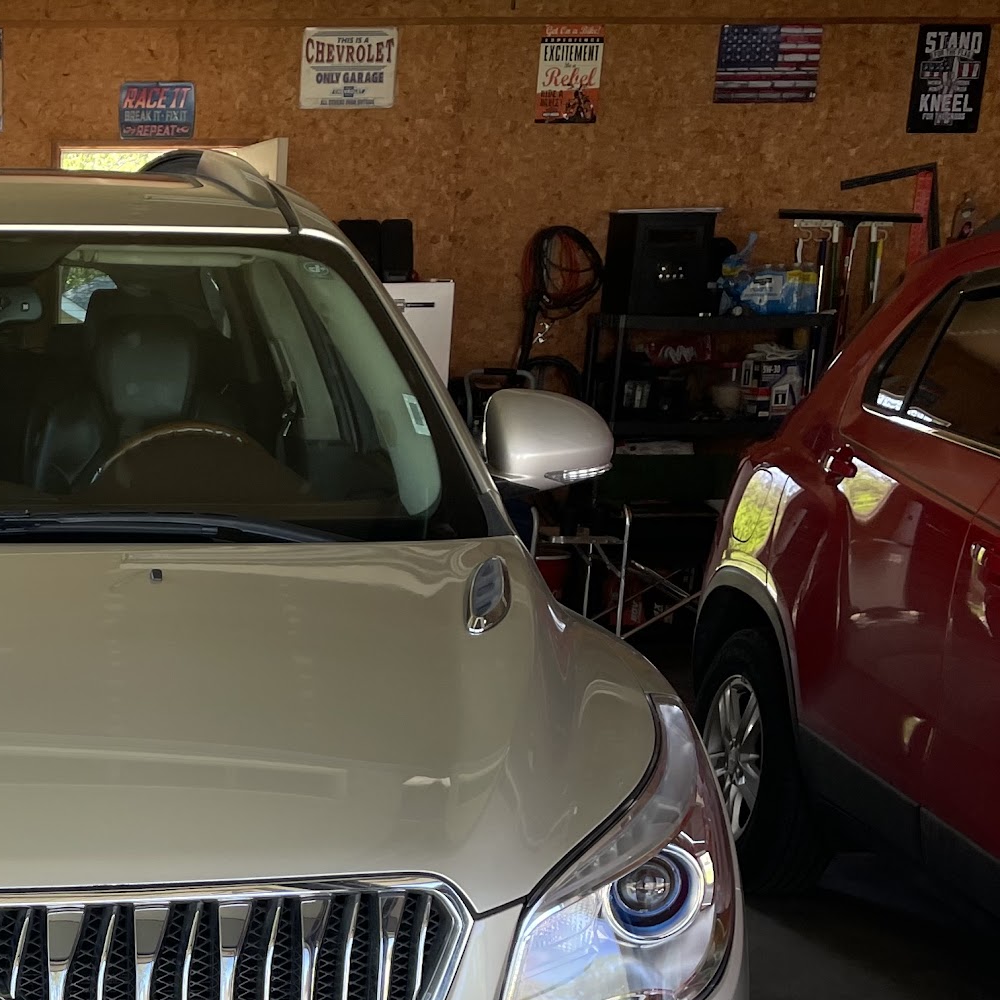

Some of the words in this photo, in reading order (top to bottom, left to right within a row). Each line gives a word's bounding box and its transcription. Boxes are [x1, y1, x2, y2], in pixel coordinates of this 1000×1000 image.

[305, 37, 395, 64] CHEVROLET
[924, 31, 983, 54] STAND
[543, 44, 600, 62] EXCITEMENT
[315, 72, 341, 84] ONLY
[342, 71, 384, 84] GARAGE
[542, 67, 597, 88] Rebel
[123, 87, 170, 109] RACE
[169, 87, 191, 109] IT
[919, 93, 973, 112] KNEEL
[124, 110, 152, 122] BREAK
[153, 110, 162, 122] IT
[136, 124, 178, 137] REPEAT
